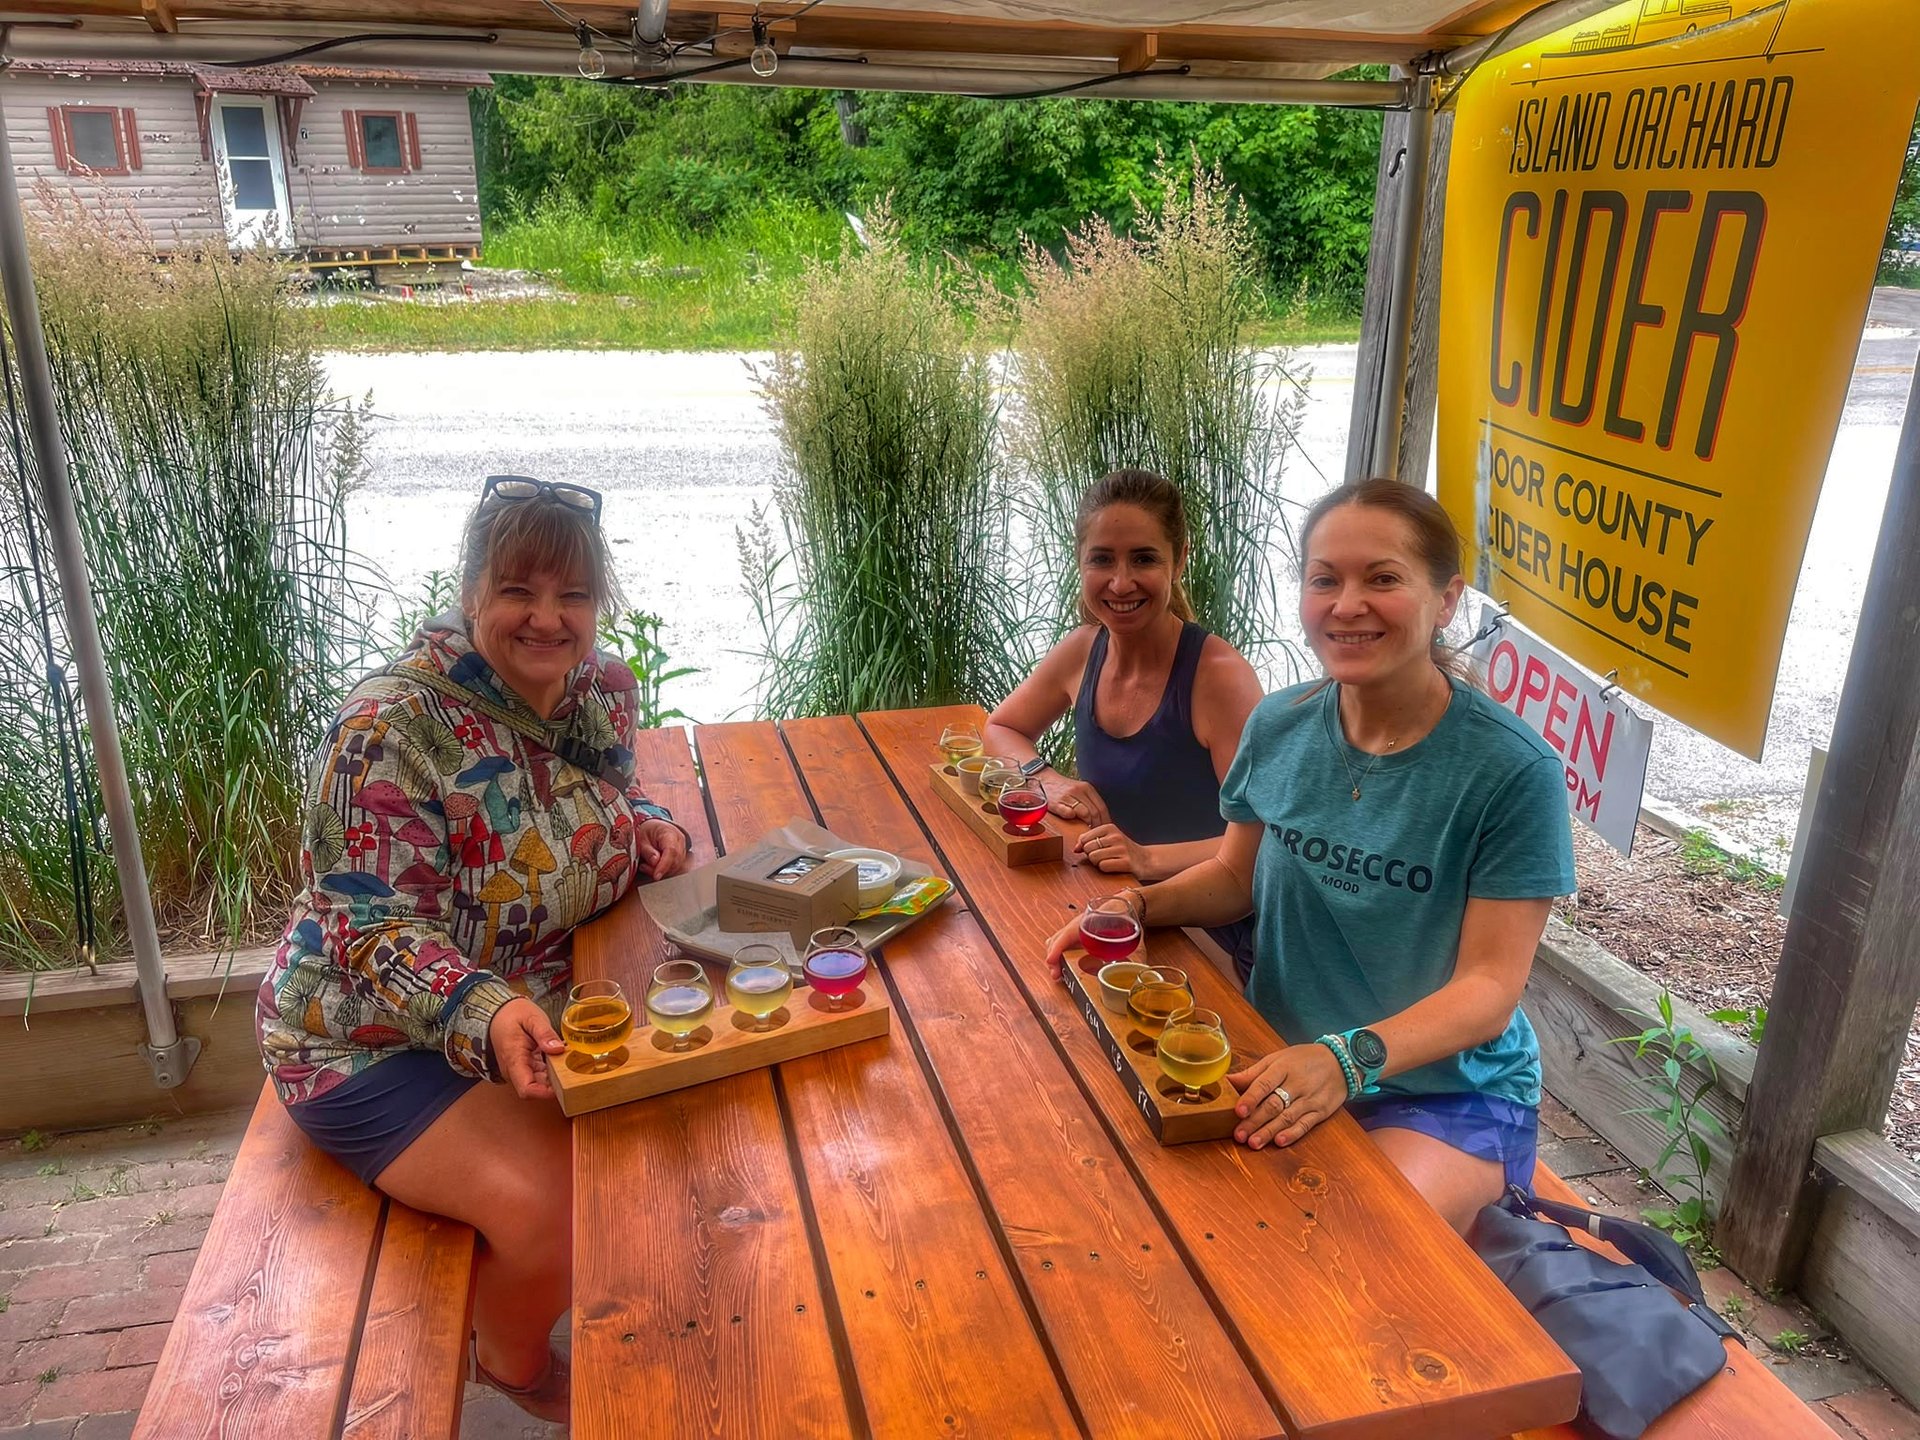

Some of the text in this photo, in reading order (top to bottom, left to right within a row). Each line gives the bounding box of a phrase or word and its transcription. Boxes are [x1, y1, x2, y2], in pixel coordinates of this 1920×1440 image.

[1508, 75, 1795, 174] ISLAND ORCHARD
[1490, 189, 1768, 462] CIDER
[1554, 473, 1714, 566] COUNTY
[1482, 504, 1699, 653] IDER HOUSE
[1488, 640, 1616, 783] OPEN
[1565, 766, 1602, 823] PM
[1321, 875, 1360, 894] MOOD
